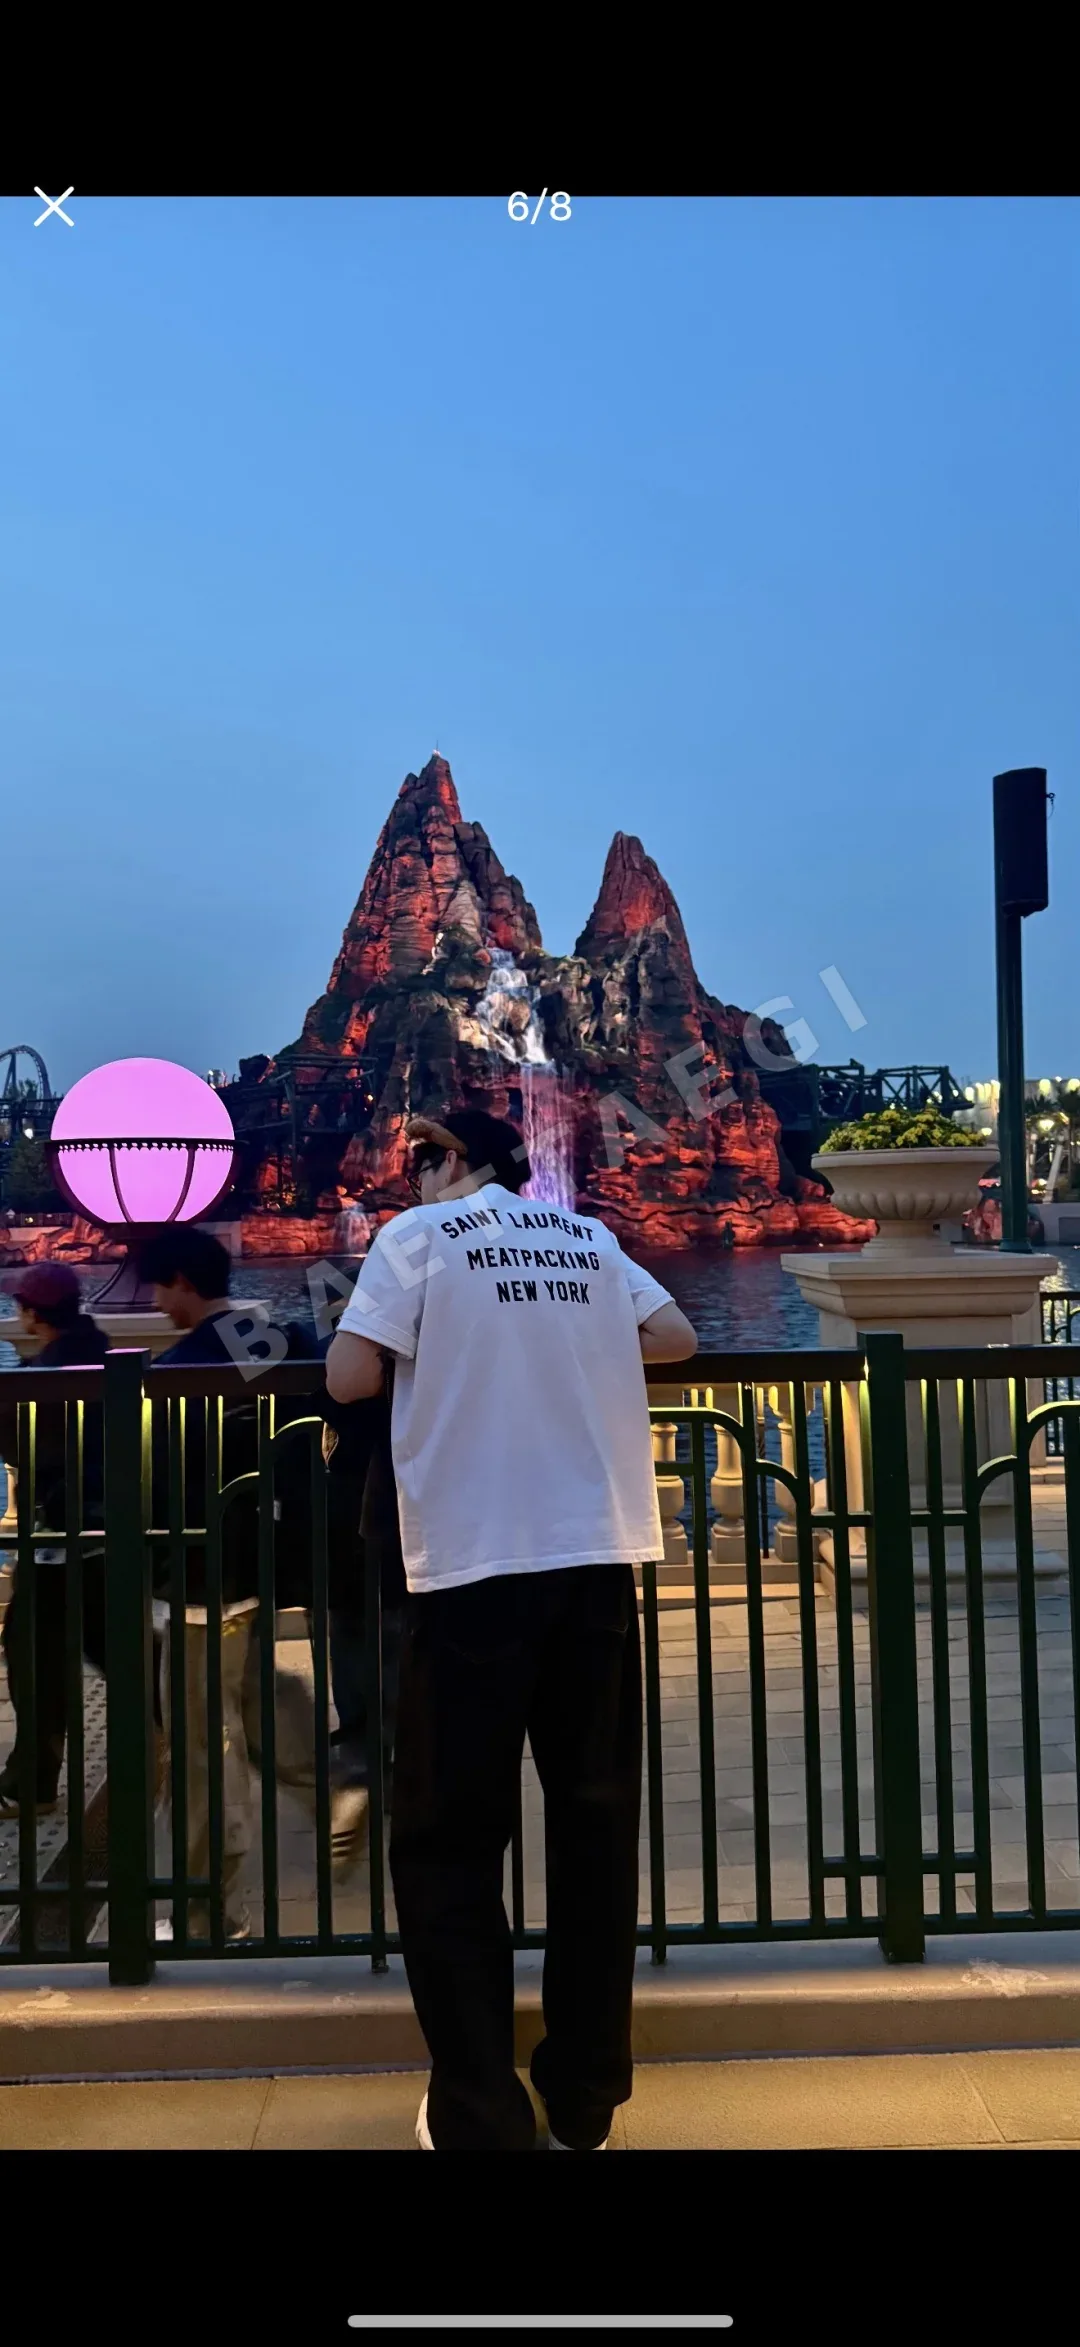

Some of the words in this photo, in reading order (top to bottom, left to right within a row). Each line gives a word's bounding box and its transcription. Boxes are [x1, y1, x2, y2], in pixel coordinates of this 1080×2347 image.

[440, 1208, 502, 1239] SAINT
[507, 1212, 593, 1242] LAURENT
[466, 1247, 600, 1271] MEATPACKING
[496, 1280, 538, 1303] NEW
[543, 1280, 591, 1305] YORK
